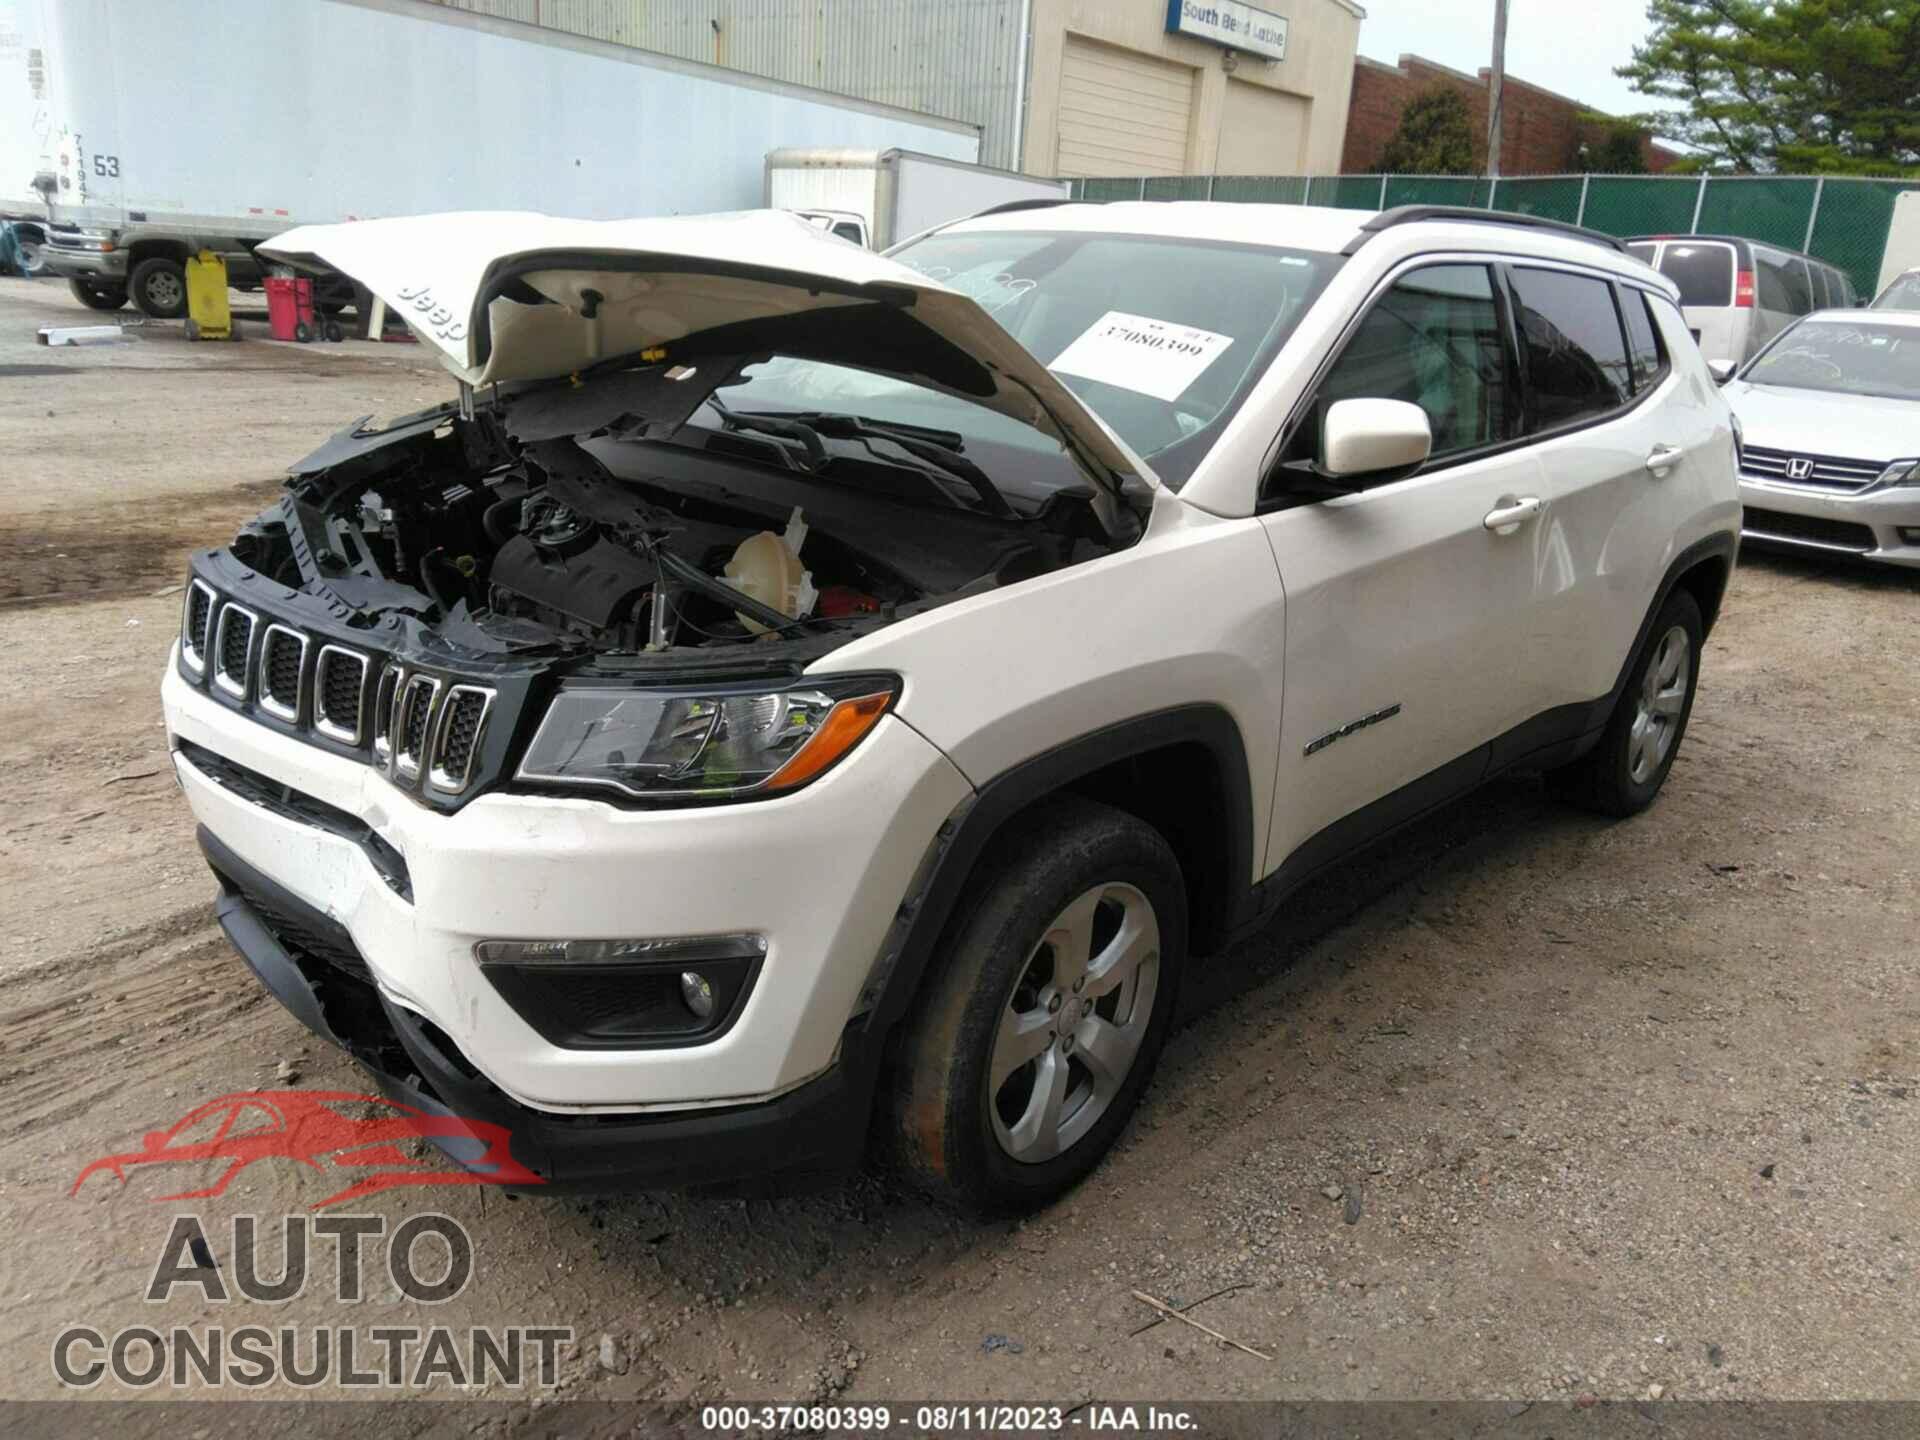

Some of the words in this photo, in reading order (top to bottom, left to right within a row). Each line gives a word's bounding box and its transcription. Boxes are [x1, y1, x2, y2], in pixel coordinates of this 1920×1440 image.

[1183, 1, 1219, 26] South
[93, 154, 120, 178] 53
[397, 287, 466, 341] Jeep
